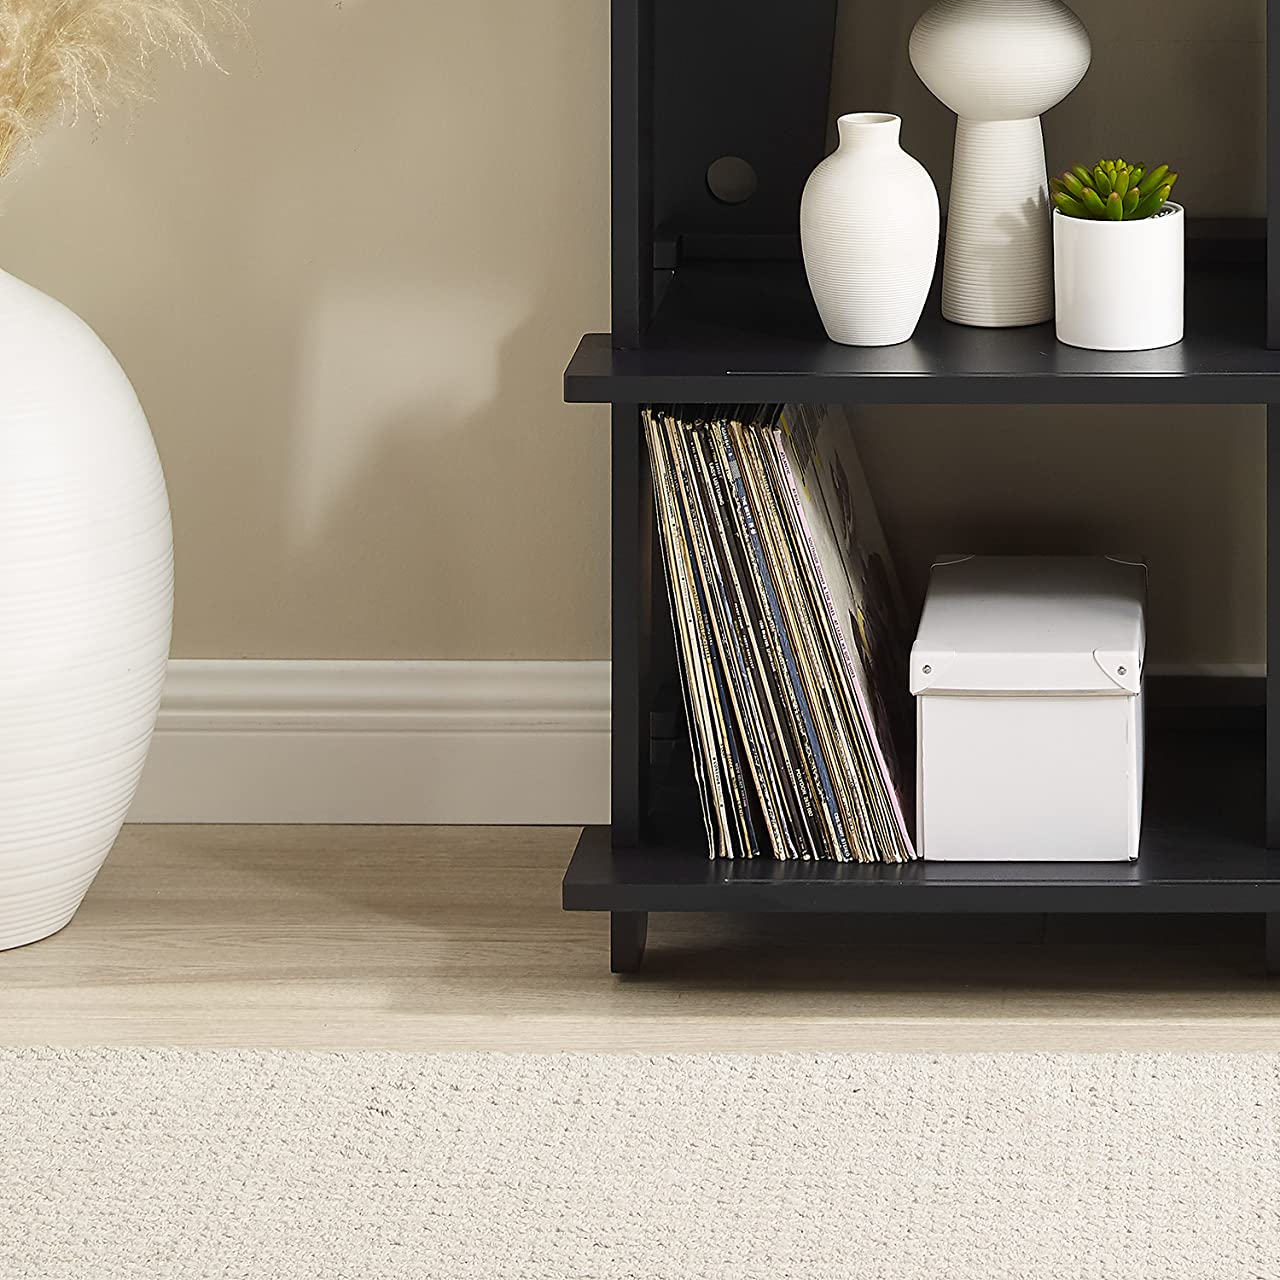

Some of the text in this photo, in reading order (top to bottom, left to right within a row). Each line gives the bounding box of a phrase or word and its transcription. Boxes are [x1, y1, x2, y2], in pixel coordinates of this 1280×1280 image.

[779, 450, 791, 475] ATLANTIC
[708, 461, 716, 477] EASY
[712, 476, 724, 506] LISTENING
[806, 536, 820, 564] SOUTHSIDE
[823, 590, 831, 601] THE
[835, 626, 844, 641] LEAST
[794, 767, 807, 795] POLYDOR
